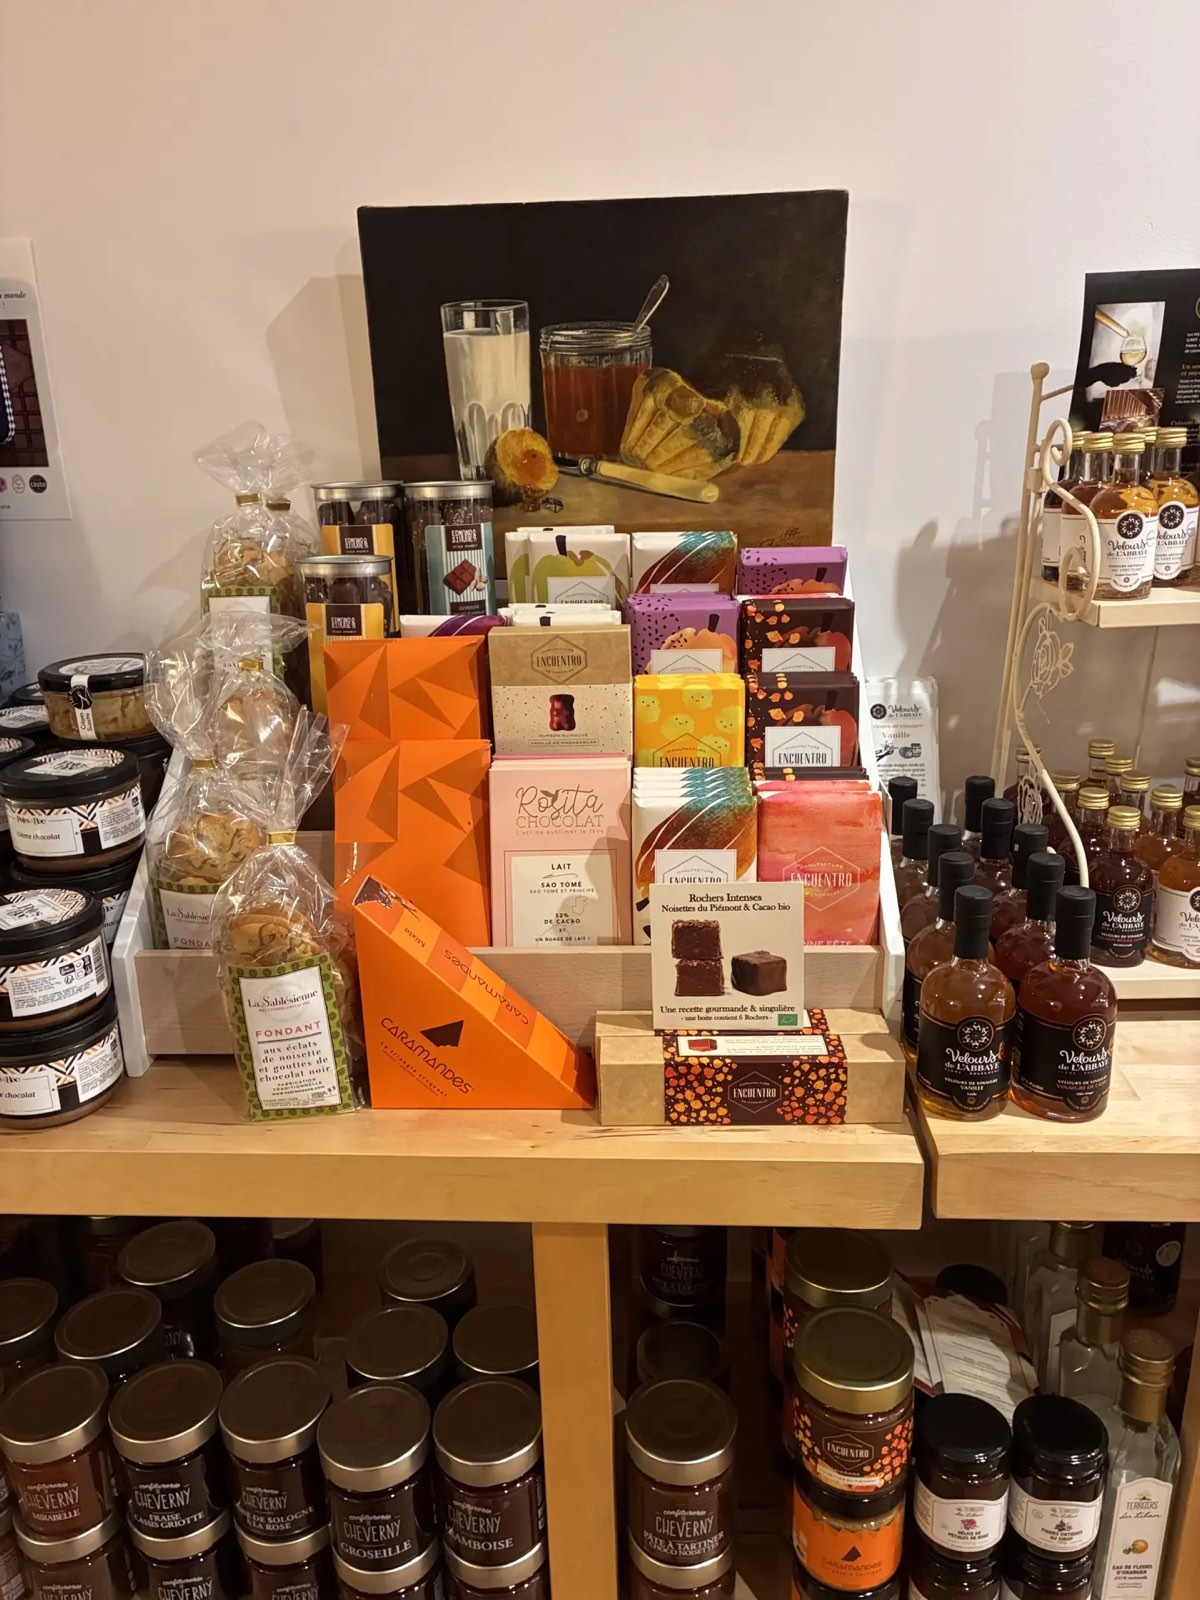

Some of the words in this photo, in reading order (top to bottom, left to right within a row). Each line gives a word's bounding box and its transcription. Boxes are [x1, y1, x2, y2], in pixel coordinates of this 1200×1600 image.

[1108, 539, 1147, 550] Velours
[536, 654, 582, 668] ENCUENTRO
[659, 756, 715, 768] ENCUENTRO
[778, 752, 827, 765] ENCUENTRO
[515, 784, 604, 821] Rosita
[515, 814, 605, 829] CHOCOLAT
[32, 832, 61, 841] chocolat
[541, 881, 557, 889] SAO
[560, 880, 582, 888] TOMÉ
[790, 873, 853, 888] ENCUENTRO
[689, 893, 725, 903] Rochers
[726, 892, 762, 902] Intenses
[661, 904, 696, 913] Noisettes
[697, 904, 709, 912] du
[709, 903, 742, 912] Piémont
[752, 903, 776, 911] Cacao
[778, 902, 791, 910] bio
[1102, 910, 1145, 923] Velours
[1111, 921, 1145, 929] L'ABBAYE
[403, 927, 427, 948] Mixto
[247, 998, 260, 1009] La
[261, 990, 318, 1009] Sablésienne
[660, 1005, 677, 1013] Une
[678, 1005, 704, 1013] recette
[705, 1004, 748, 1014] gourmande
[759, 1003, 796, 1014] singulière
[713, 1013, 738, 1021] contient
[744, 1013, 769, 1021] Rochers
[255, 1020, 321, 1038] FONDANT
[263, 1047, 282, 1055] aux
[286, 1040, 318, 1051] éclats
[262, 1055, 274, 1064] de
[279, 1049, 322, 1062] noisette
[945, 1048, 998, 1064] Velours
[1059, 1047, 1108, 1064] Velours
[258, 1065, 268, 1074] et
[273, 1060, 312, 1074] gouttes
[316, 1056, 329, 1065] de
[944, 1061, 955, 1069] de
[956, 1061, 1000, 1072] L'ABBAYE
[1058, 1063, 1070, 1071] de
[1071, 1058, 1109, 1072] L'ABBAYE
[259, 1071, 305, 1083] chocolat
[309, 1065, 331, 1076] noir
[944, 1077, 968, 1085] VELOURS
[277, 1077, 317, 1087] FABRICATION
[4, 1091, 36, 1099] chocolat
[733, 1087, 777, 1099] ENCUENTRO
[827, 1441, 869, 1459] ENCUENTRO
[23, 1486, 80, 1510] CHEVERNY
[134, 1486, 191, 1510] CHEVERNY
[241, 1490, 288, 1511] CHEVERNY
[1126, 1501, 1159, 1510] TERROIRS
[32, 1508, 81, 1522] MIRABELLE
[149, 1513, 181, 1522] FRAISE
[160, 1511, 206, 1529] GRIOTTE
[252, 1514, 266, 1523] DE
[267, 1504, 316, 1524] SOLOGNE
[447, 1505, 502, 1534] CHEVERNY
[1134, 1511, 1162, 1519] Liban
[252, 1521, 265, 1530] LA
[265, 1522, 292, 1531] ROSE
[343, 1520, 401, 1544] CHEVERNY
[655, 1515, 714, 1538] CHEVERNY
[447, 1528, 514, 1551] AMBOISE
[675, 1530, 725, 1552] TARTINER
[340, 1539, 413, 1560] GROSEILLE
[648, 1541, 677, 1556] CHOCO
[678, 1542, 721, 1557] NOISETTES
